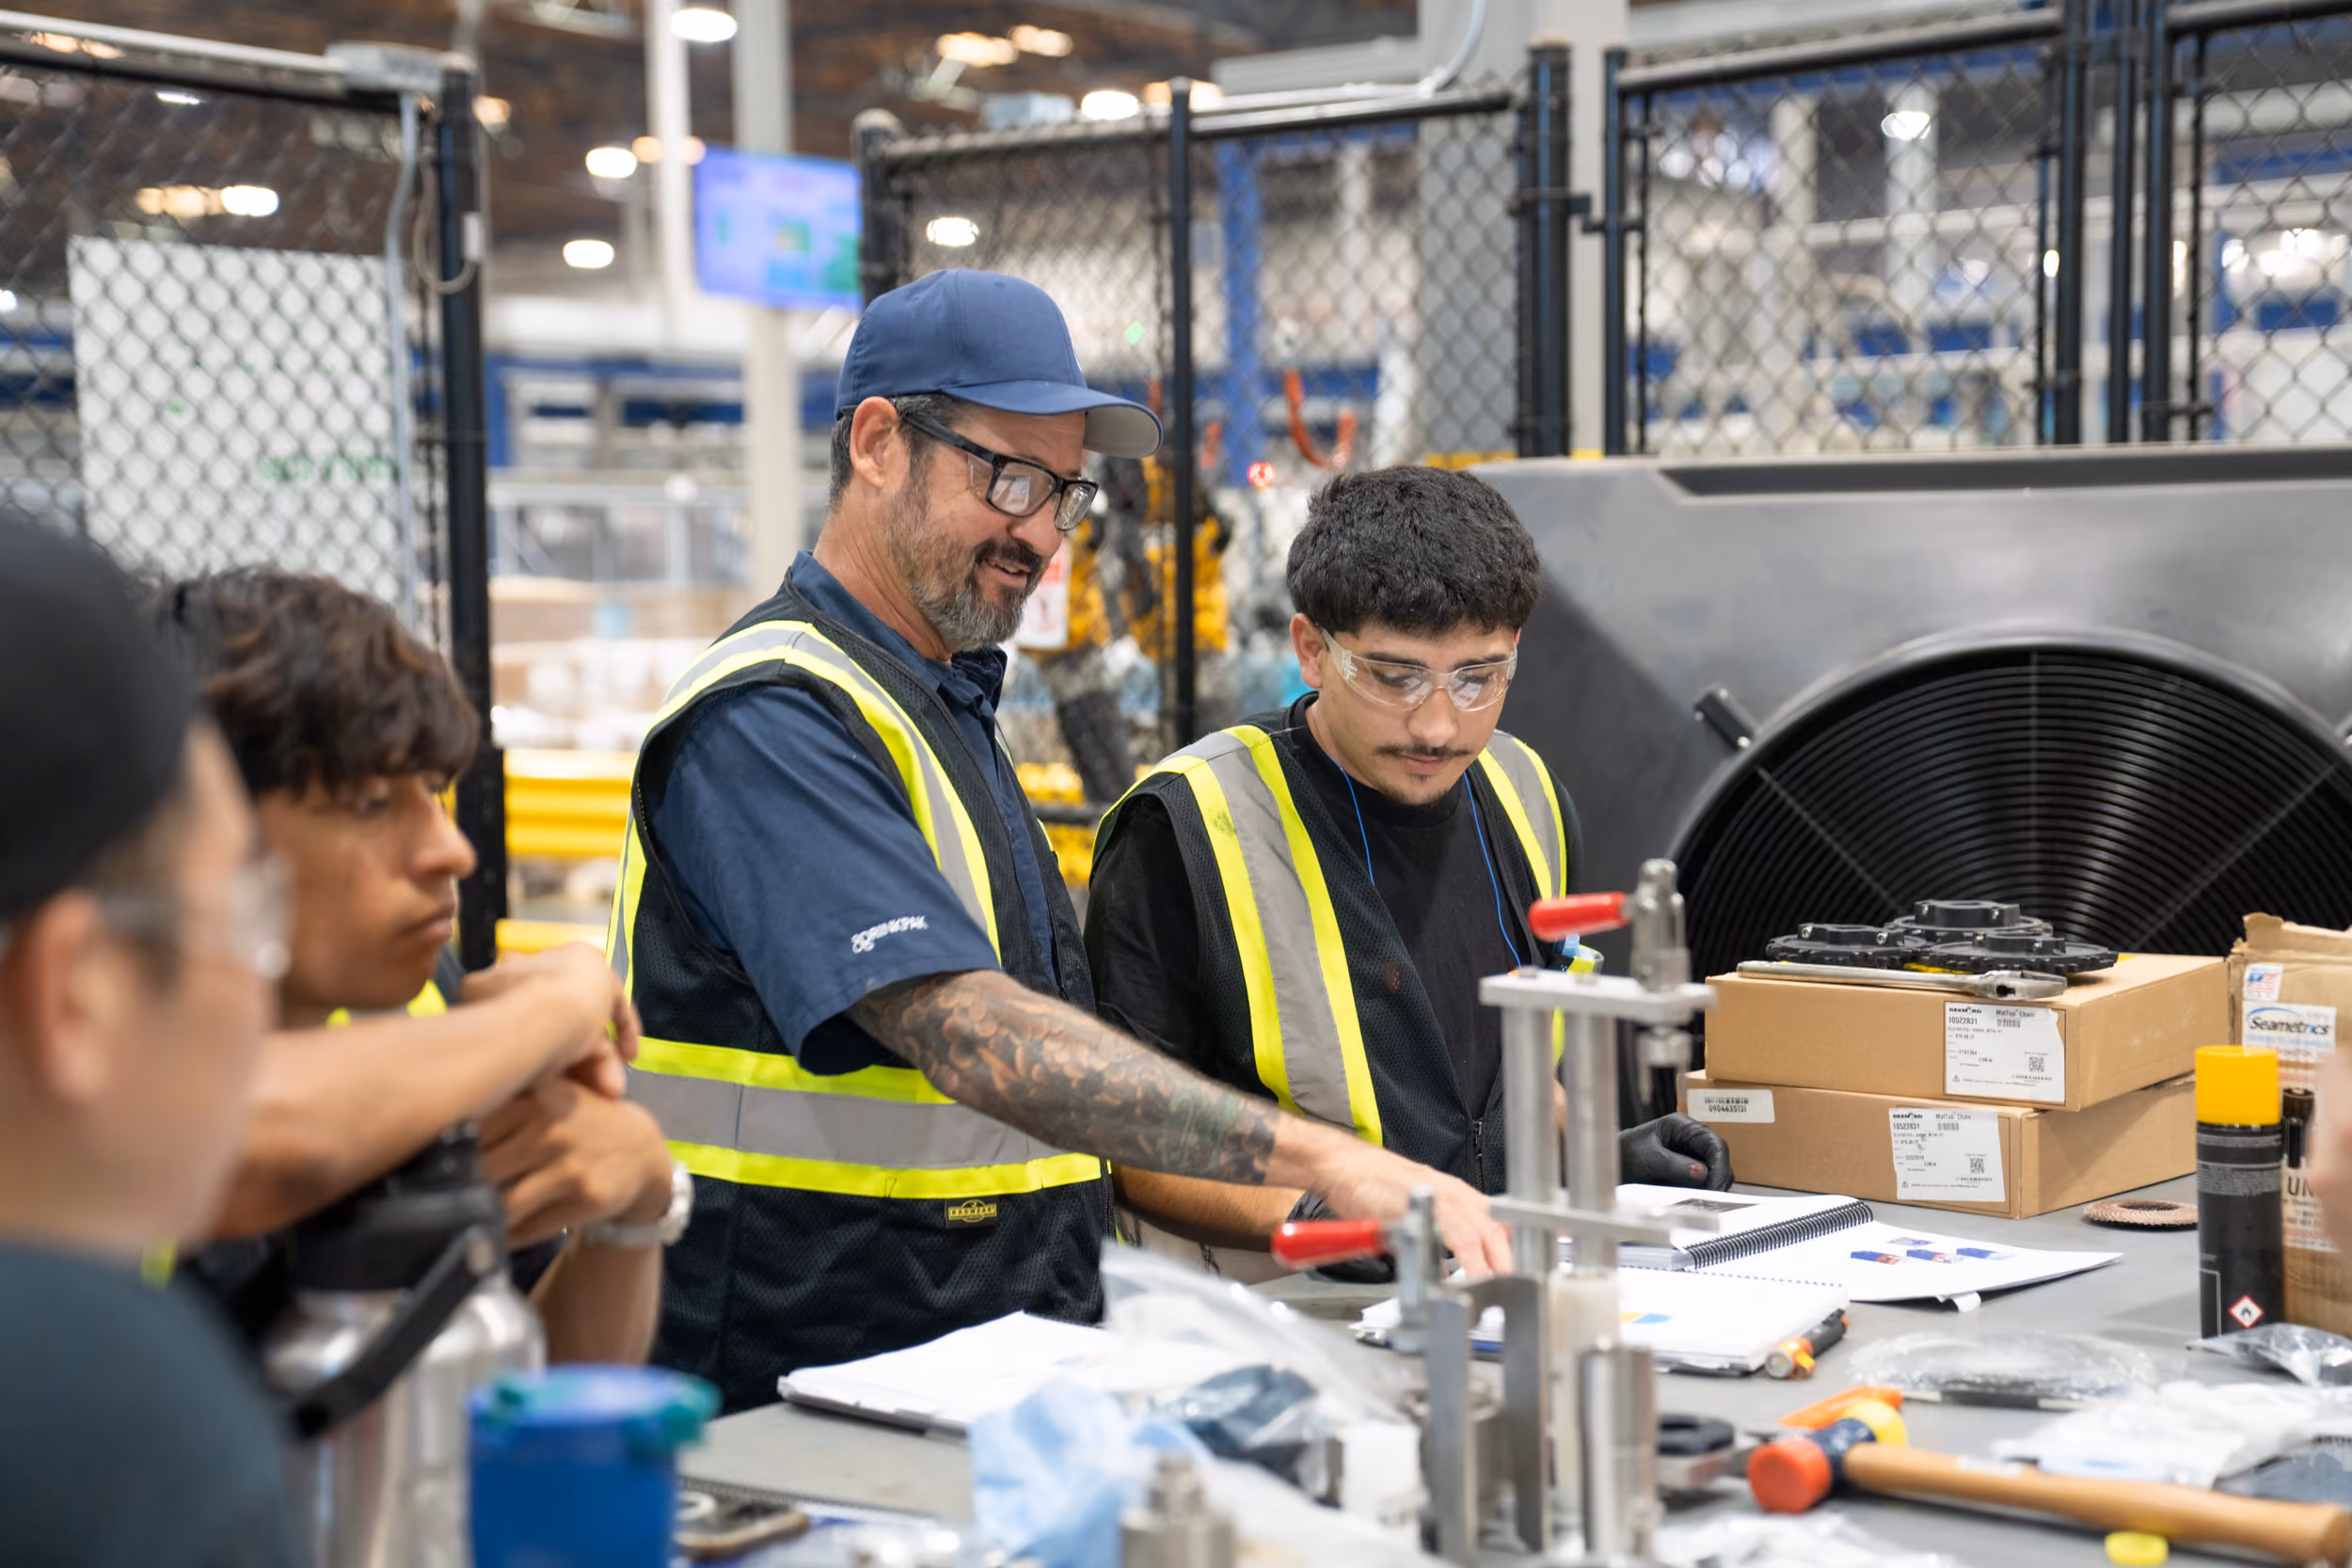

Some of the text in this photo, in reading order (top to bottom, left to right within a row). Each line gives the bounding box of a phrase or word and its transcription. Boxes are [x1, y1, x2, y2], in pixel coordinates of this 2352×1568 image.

[1948, 1016, 1978, 1025] 10522831
[2249, 1016, 2330, 1036] Seametrics
[1892, 1122, 1920, 1131] 10522831
